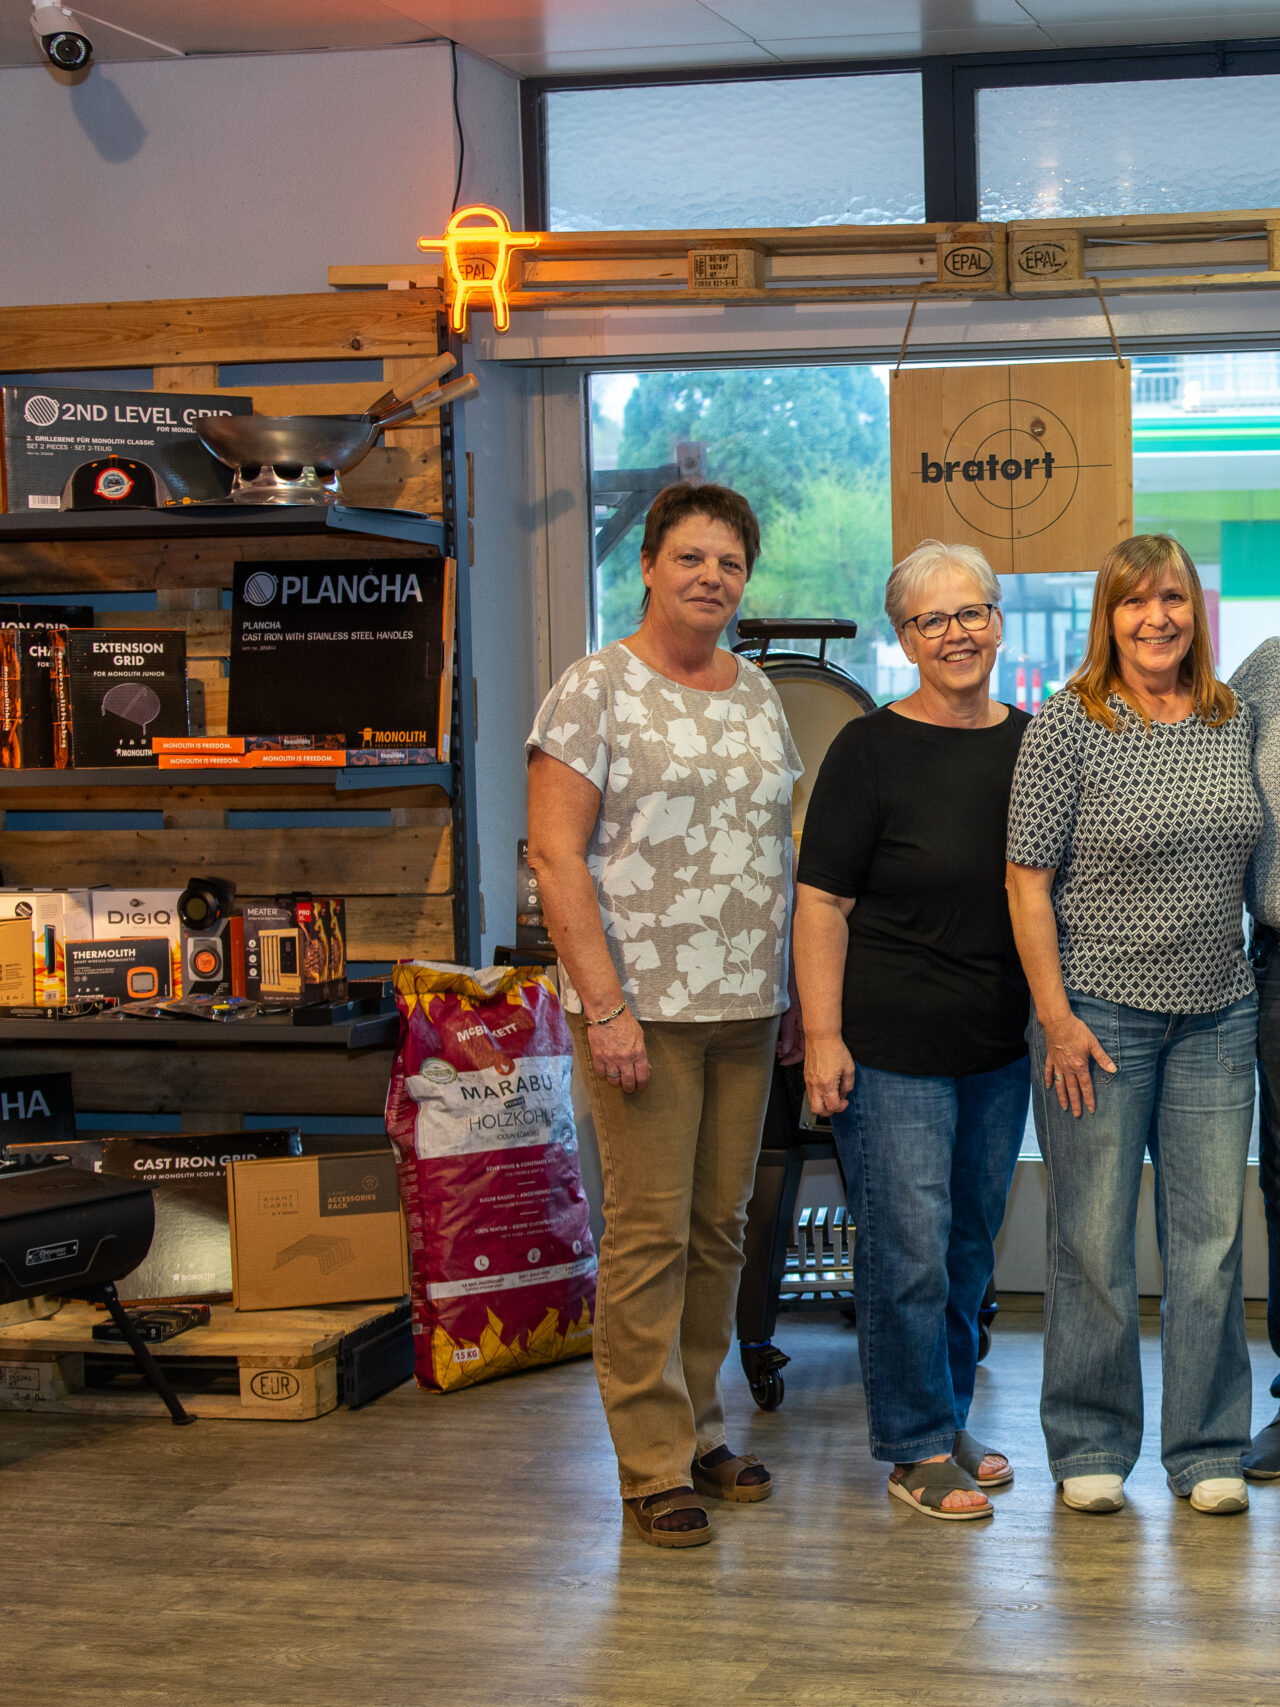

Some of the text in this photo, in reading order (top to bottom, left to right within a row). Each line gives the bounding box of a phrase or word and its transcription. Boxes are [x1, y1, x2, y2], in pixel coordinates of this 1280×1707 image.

[952, 253, 986, 271] EPAL
[1026, 250, 1062, 269] EPAL
[61, 403, 108, 422] 2ND
[115, 405, 178, 425] LEVEL
[91, 437, 126, 445] MONOLITH
[921, 451, 1055, 484] bratort
[281, 573, 424, 605] PLANCHA
[242, 621, 282, 630] PLANCHA
[242, 630, 414, 642] CAST IRON WITH STAINLESS STEEL HANDLES
[92, 642, 164, 654] EXTENSION
[113, 655, 145, 666] GRID
[375, 731, 427, 743] MONOLITH
[163, 741, 233, 749] MONOLITH IS FREEDOM.
[121, 749, 153, 757] MONOLITH
[262, 754, 334, 763] MONOLITH IS FREEDOM.
[169, 756, 241, 765] MONOLITH IS FREEDOM.
[247, 908, 277, 916] MEATER
[72, 948, 136, 960] THERMOLITH
[456, 1022, 519, 1043] McBKETT
[460, 1074, 553, 1100] MARABU
[1, 1089, 51, 1121] HA
[469, 1107, 557, 1132] HOLZKOHLE
[133, 1157, 172, 1171] CAST
[175, 1155, 216, 1169] IRON
[158, 1172, 195, 1180] MONOLITH
[327, 1194, 377, 1204] ACCESSORIES
[455, 1350, 478, 1361] 15 KG
[259, 1376, 291, 1396] EUR
